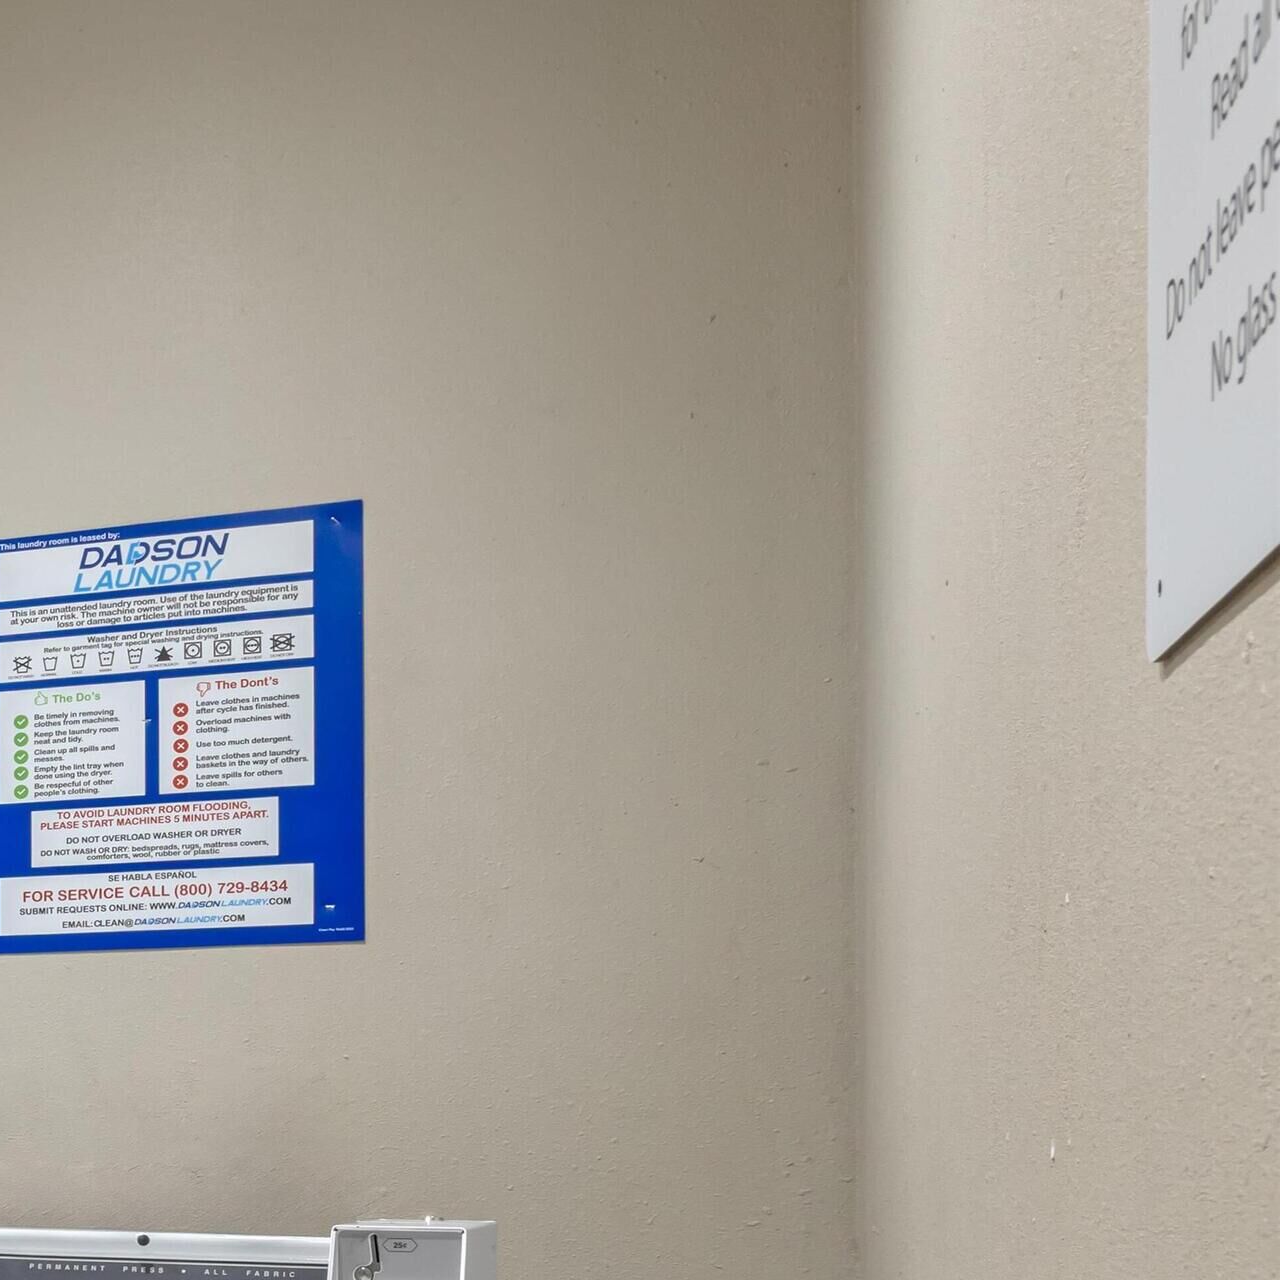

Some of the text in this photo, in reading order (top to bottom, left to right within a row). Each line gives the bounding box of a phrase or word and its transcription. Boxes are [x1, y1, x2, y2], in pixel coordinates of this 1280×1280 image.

[1211, 13, 1249, 140] Read
[1166, 277, 1186, 341] Do
[1189, 226, 1213, 305] not
[1216, 162, 1256, 263] leave
[1211, 271, 1277, 402] No glass
[0, 542, 16, 550] This
[17, 540, 47, 549] laundry
[79, 533, 106, 542] leased
[108, 532, 120, 540] by:
[79, 532, 230, 569] DADSON
[73, 559, 223, 593] LAUNDRY
[10, 609, 27, 618] This
[29, 608, 36, 616] is
[50, 602, 98, 614] unattended
[99, 600, 131, 609] laundry
[133, 598, 158, 606] room.
[160, 596, 177, 604] Use
[179, 594, 188, 602] of
[189, 593, 204, 601] the
[206, 590, 239, 599] laundry
[241, 584, 289, 597] equipment
[57, 620, 74, 628] loss
[87, 616, 121, 625] damage
[123, 614, 132, 622] to
[133, 611, 166, 621] articles
[167, 609, 182, 619] put
[184, 608, 201, 616] into
[203, 605, 247, 614] machines.
[88, 627, 217, 643] Washer and Dryer Instructions
[215, 676, 279, 690] The Dont's
[53, 691, 101, 704] The Do's
[196, 716, 232, 725] Overload
[233, 715, 272, 723] machines
[196, 725, 230, 733] clothing.
[79, 745, 99, 753] spills
[101, 743, 115, 751] and
[228, 737, 250, 745] much
[251, 735, 293, 744] detergent.
[58, 801, 251, 820] TO AVOID LAUNDRY ROOM FLOODING,
[40, 810, 269, 830] PLEASE START MACHINES 5 MINUTES APART.
[66, 836, 79, 844] DO
[81, 835, 100, 843] NOT
[102, 833, 151, 842] OVERLOAD
[153, 830, 193, 840] WASHER
[210, 828, 242, 837] DRYER
[87, 852, 131, 860] comforters,
[193, 848, 220, 856] plastic
[133, 844, 180, 853] bedspreads,
[108, 870, 197, 882] SE HABLA ESPAÑOL
[23, 881, 288, 902] FOR SERVICE CALL (800) 729-8434
[19, 907, 55, 915] SUBMIT
[56, 905, 107, 914] REQUESTS
[109, 903, 148, 912] ONLINE:
[29, 1263, 105, 1271] PERMANENT
[122, 1265, 164, 1274] PRESS
[246, 1270, 295, 1278] FABRIC
